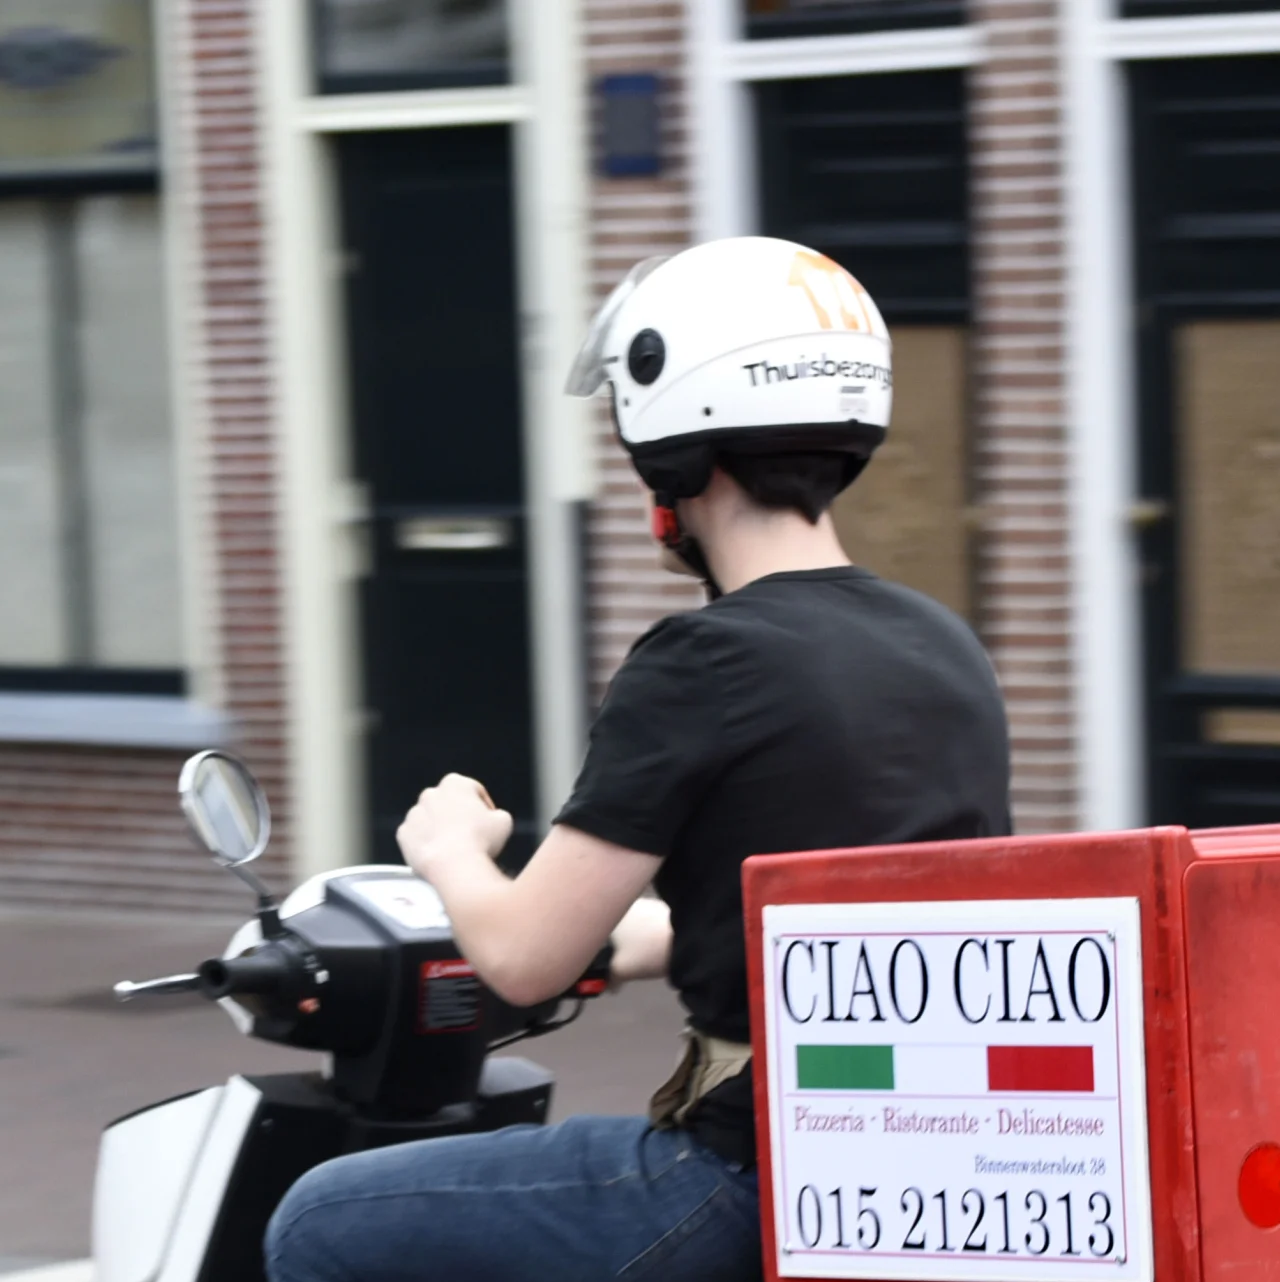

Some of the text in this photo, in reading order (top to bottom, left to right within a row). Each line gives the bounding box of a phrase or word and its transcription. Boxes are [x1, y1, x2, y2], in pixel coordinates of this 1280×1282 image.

[781, 936, 1111, 1025] CIAO CIAO
[794, 1105, 1104, 1136] Pizzeria Ristorante Delicatesse
[796, 1184, 1115, 1258] 015 2121313
